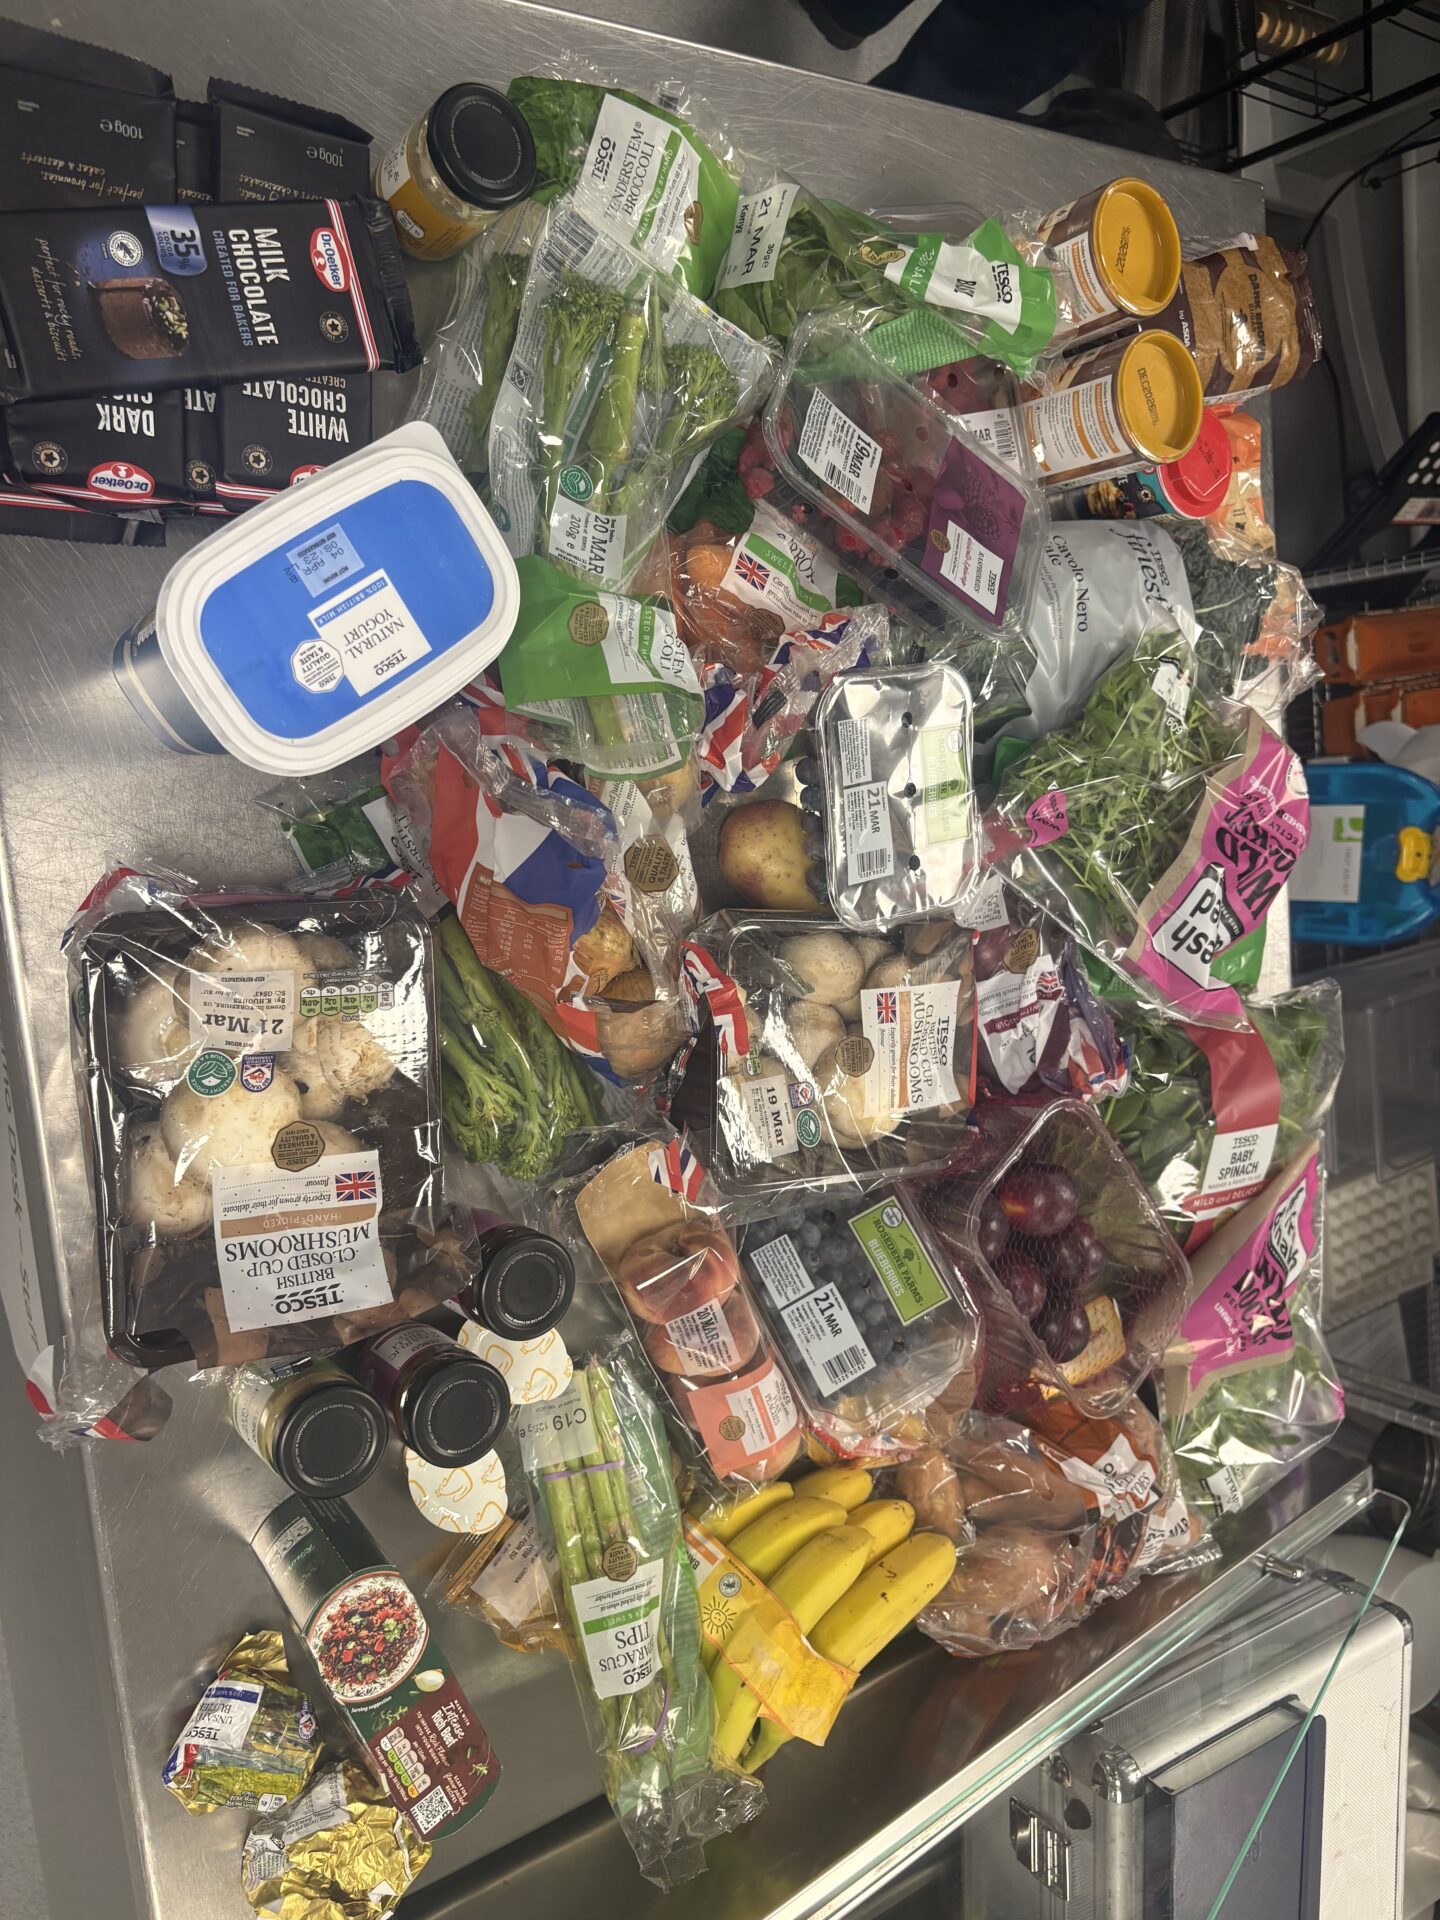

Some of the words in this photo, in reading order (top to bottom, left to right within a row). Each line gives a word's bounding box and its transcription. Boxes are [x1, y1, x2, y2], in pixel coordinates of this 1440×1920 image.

[21, 152, 65, 171] desserts
[68, 162, 75, 171] &
[77, 163, 106, 177] cakes
[591, 137, 612, 180] TESCO
[89, 178, 105, 197] for
[240, 174, 293, 198] cheesecakes
[622, 141, 655, 217] BROCCOLI
[106, 183, 144, 202] perfect
[758, 196, 772, 218] 21
[735, 204, 750, 235] Kenya
[156, 231, 166, 258] SOLIDS
[162, 231, 172, 258] COCOA
[212, 230, 235, 278] CREATED
[253, 228, 290, 282] MILK
[741, 226, 765, 277] MAR
[35, 238, 61, 277] perfect
[320, 232, 343, 288] Dr.Oetker
[44, 280, 66, 296] for
[225, 280, 242, 301] FOR
[229, 229, 279, 346] CHOCOLATE
[996, 263, 1014, 304] TESCO
[1251, 274, 1265, 309] DARK
[31, 266, 54, 309] desserts
[47, 321, 68, 361] biscuits
[54, 297, 74, 327] rocky
[1249, 303, 1257, 333] SUGAR
[232, 304, 254, 347] BAKERS
[1182, 321, 1193, 348] ASDA
[1257, 313, 1269, 363] BROWN
[242, 380, 347, 414] CHOCOLATE
[95, 403, 156, 438] DARK
[288, 408, 350, 443] WHITE
[91, 474, 150, 494] Dr.Oetker
[565, 513, 582, 541] 200g
[593, 514, 610, 534] 20
[329, 546, 345, 561] 04
[588, 536, 608, 576] MAR
[766, 549, 794, 573] SWEET
[301, 559, 326, 575] APR
[973, 551, 986, 595] RASPBERRIES
[1109, 528, 1169, 604] finest
[1154, 550, 1171, 587] TESCO
[364, 579, 386, 597] 100%
[988, 572, 999, 596] TESCO
[1051, 535, 1085, 583] Cavolo
[1076, 588, 1090, 633] Nero
[335, 590, 366, 612] BRITISH
[314, 608, 337, 627] MILK
[342, 608, 394, 646] YOGURT
[344, 617, 405, 660] NATURAL
[643, 635, 650, 646] BY
[298, 650, 319, 665] TASTE
[301, 652, 331, 673] QUALITY
[375, 653, 408, 677] TESCO
[317, 673, 339, 689] TESCO
[926, 755, 940, 818] BLUEBERRIES
[867, 787, 881, 810] 21
[868, 810, 882, 835] MAR
[941, 796, 952, 833] FARMS
[629, 847, 643, 870] TESCO
[649, 847, 665, 884] QUALITY
[660, 852, 673, 876] TASTE
[264, 1003, 286, 1011] Grown
[274, 996, 286, 1005] By:
[201, 1013, 250, 1034] Mar
[259, 1018, 284, 1034] 21
[918, 1004, 935, 1056] CLOSED
[879, 1028, 887, 1048] flavour
[908, 992, 925, 1105] MUSHROOMS
[929, 1021, 940, 1066] BRITISH
[939, 1016, 951, 1067] TESCO
[889, 1049, 897, 1066] grown
[889, 1066, 897, 1075] for
[922, 1060, 934, 1087] CUP
[191, 1077, 210, 1093] CHOICE
[208, 1076, 232, 1094] HEALTHY
[766, 1086, 778, 1105] 19
[279, 1134, 310, 1143] QUALITY
[771, 1110, 785, 1146] Mar
[278, 1139, 319, 1149] FRESHNESS
[1232, 1134, 1259, 1148] TESCO
[1229, 1151, 1258, 1164] BABY
[304, 1178, 331, 1189] flavour
[1218, 1167, 1259, 1181] SPINACH
[222, 1204, 250, 1215] delicate
[250, 1201, 268, 1210] their
[268, 1198, 280, 1208] for
[278, 1195, 301, 1205] grown
[302, 1193, 331, 1203] Expertly
[1193, 1199, 1214, 1208] MILD
[262, 1212, 339, 1229] HAND-PICKED
[223, 1222, 371, 1262] MUSHROOMS
[246, 1260, 284, 1278] CUP
[286, 1246, 356, 1271] CLOSED
[867, 1239, 905, 1297] BLUEBERRIES
[873, 1218, 905, 1269] ROSEDENE
[901, 1269, 923, 1304] FARMS
[277, 1267, 336, 1291] BRITISH
[274, 1290, 344, 1315] TESCO
[697, 1307, 711, 1322] 20
[813, 1291, 835, 1317] 21
[826, 1313, 844, 1339] MAR
[700, 1320, 719, 1344] MAR
[553, 1408, 586, 1431] C19
[508, 1550, 518, 1561] EU
[515, 1536, 528, 1552] FOR
[608, 1551, 632, 1566] QUALITY
[513, 1566, 528, 1585] CHINA
[616, 1569, 631, 1578] TESCO
[594, 1592, 611, 1603] tender
[607, 1602, 620, 1611] when
[614, 1620, 652, 1650] TIPS
[624, 1664, 653, 1686] TESCO
[198, 1702, 232, 1714] BUTTER
[351, 1706, 370, 1714] Serving
[368, 1695, 393, 1709] suggestion
[454, 1700, 464, 1713] MADE
[462, 1714, 471, 1727] WITH
[420, 1718, 430, 1734] INFUSE
[431, 1709, 446, 1732] Rich
[439, 1726, 459, 1749] Beef
[442, 1702, 465, 1739] Intense
[186, 1730, 218, 1741] TESCO
[415, 1723, 424, 1735] INTO
[422, 1736, 431, 1749] YOUR
[429, 1750, 441, 1766] DISHES
[445, 1785, 457, 1804] RECIPES
[454, 1775, 463, 1788] SCAN
[460, 1787, 468, 1798] FOR
